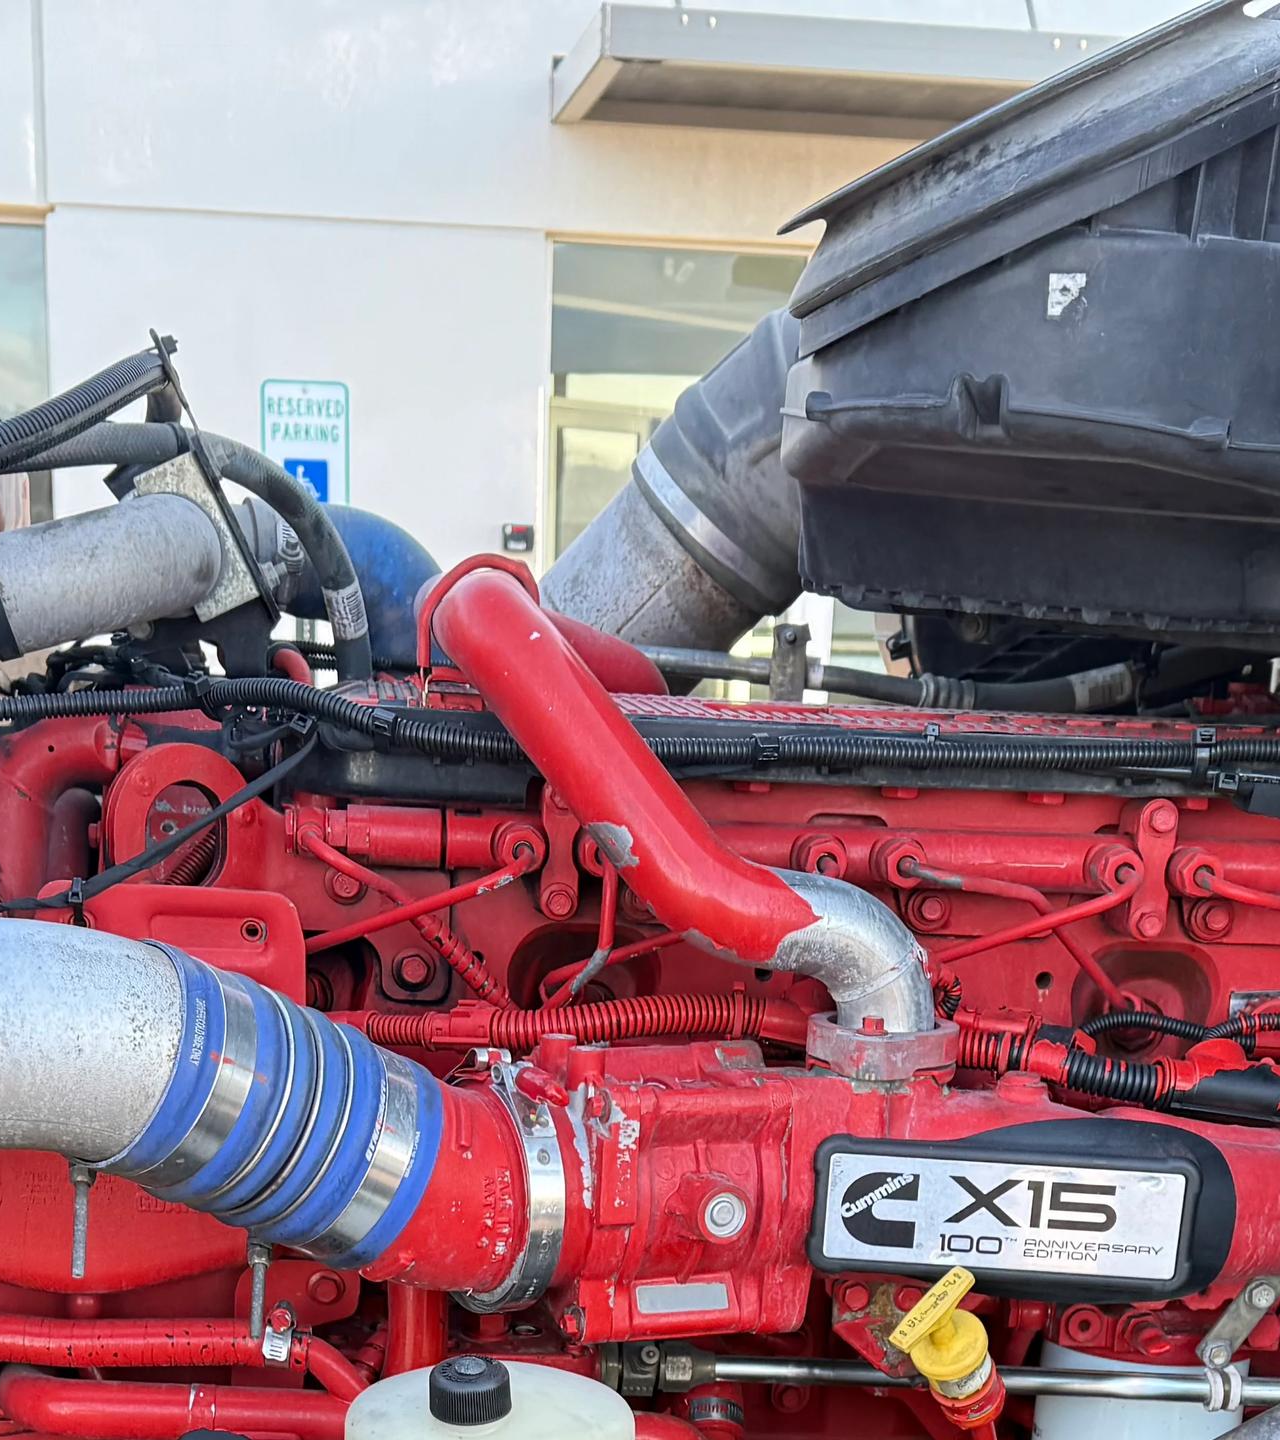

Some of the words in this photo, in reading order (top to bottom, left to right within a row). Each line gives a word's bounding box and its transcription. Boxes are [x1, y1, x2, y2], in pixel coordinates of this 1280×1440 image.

[267, 397, 344, 419] RESERVED
[271, 422, 340, 443] PARKING
[841, 1172, 915, 1218] Cummins
[943, 1175, 1117, 1233] X15
[1023, 1238, 1165, 1257] ANNIVERSARY
[1023, 1248, 1098, 1262] EDITION
